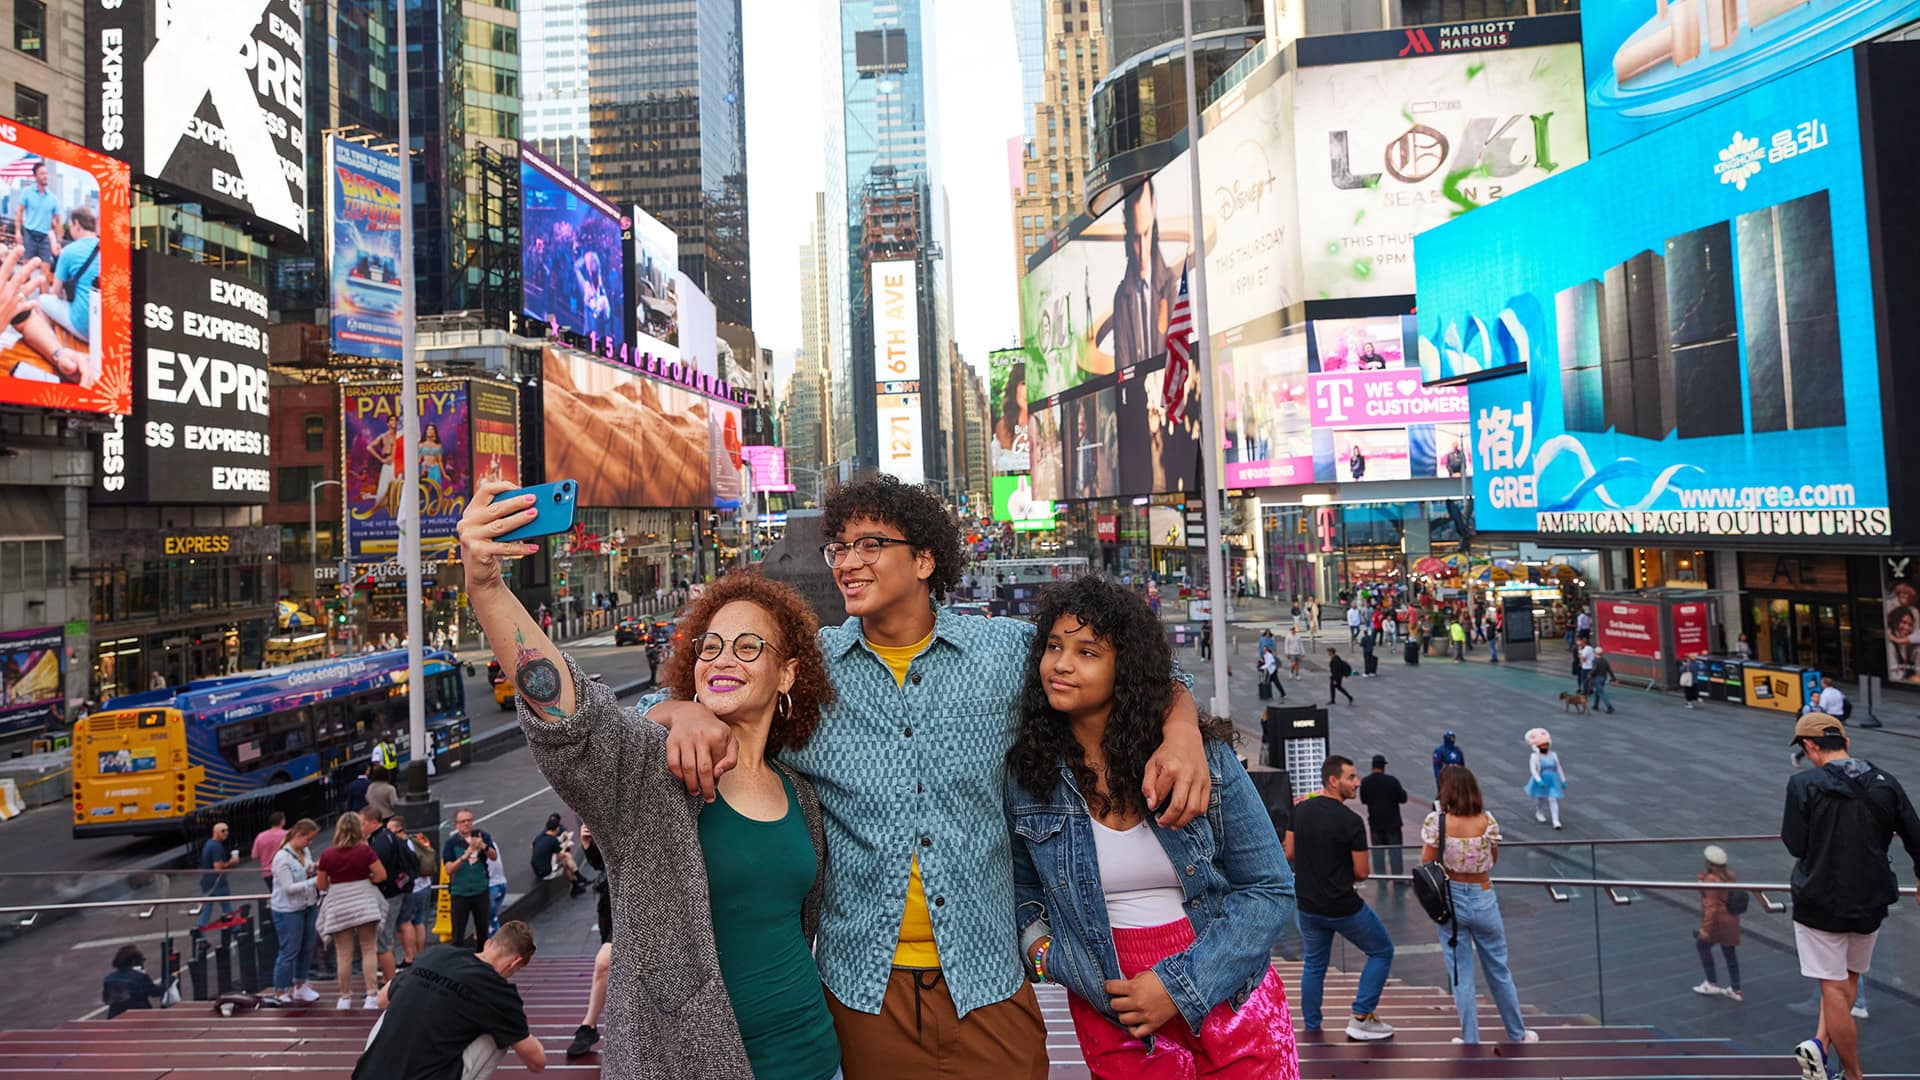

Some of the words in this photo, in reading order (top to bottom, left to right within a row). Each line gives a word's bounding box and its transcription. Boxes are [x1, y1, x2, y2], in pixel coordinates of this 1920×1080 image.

[1439, 20, 1515, 37] MARRIOTT
[1440, 34, 1508, 50] MARQUIS
[101, 28, 124, 151] EXPRESS
[1328, 111, 1559, 191] LOKI
[1383, 184, 1476, 208] SEASN
[1487, 184, 1504, 199] 2
[1341, 234, 1373, 249] THIS
[1376, 252, 1407, 265] 9PM
[884, 274, 905, 321] AVE
[144, 302, 174, 331] SS
[183, 311, 261, 350] EXPRESS
[886, 329, 908, 375] 6TH
[589, 330, 642, 368] 1540
[646, 352, 733, 400] BROADWAY
[346, 384, 402, 397] BROADWA
[418, 381, 465, 393] BIGGEST
[1364, 382, 1394, 398] WE
[1366, 395, 1469, 417] CUSTOMERS
[145, 422, 174, 448] SS
[184, 425, 262, 456] EXPRESS
[890, 415, 912, 460] 1271
[1678, 483, 1856, 510] www.gree.com
[1538, 511, 1635, 534] AMERICAN
[1642, 511, 1709, 534] EAGLE
[1717, 508, 1888, 535] OUTFITTERS
[164, 535, 230, 554] EXPRESS
[314, 564, 356, 579] GIFS
[367, 562, 438, 579] LUGGGE
[287, 664, 349, 686] clean-energy
[349, 661, 366, 673] bus
